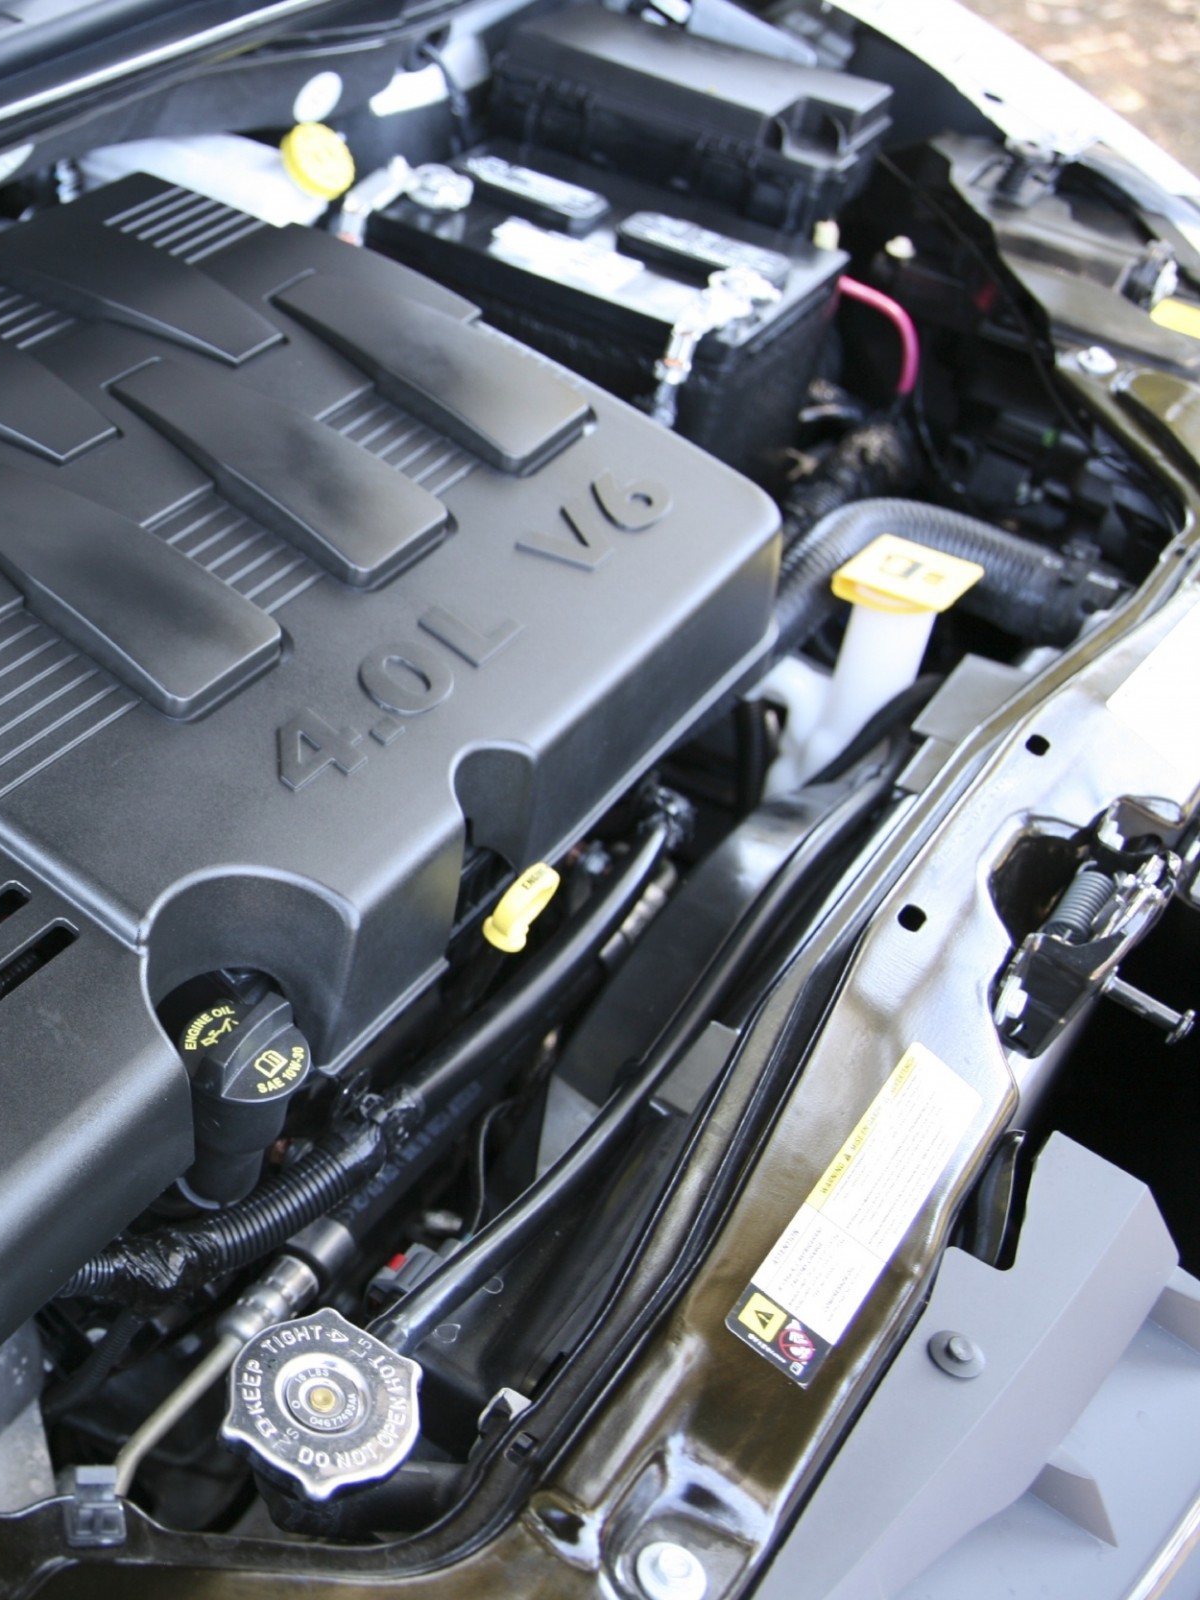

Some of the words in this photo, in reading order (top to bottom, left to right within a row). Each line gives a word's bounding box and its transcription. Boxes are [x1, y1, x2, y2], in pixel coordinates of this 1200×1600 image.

[276, 603, 525, 792] 4.0L
[514, 468, 675, 573] V6
[185, 1013, 213, 1050] ENGINE
[211, 1006, 236, 1018] OIL
[256, 1077, 285, 1094] SAE
[282, 1046, 305, 1080] 10W-30
[242, 1359, 264, 1415] KEEP
[261, 1325, 323, 1353] TIGHT
[368, 1354, 405, 1393] HOT
[377, 1397, 407, 1448] OPEN
[298, 1448, 330, 1467] DO
[336, 1444, 379, 1469] NOT
